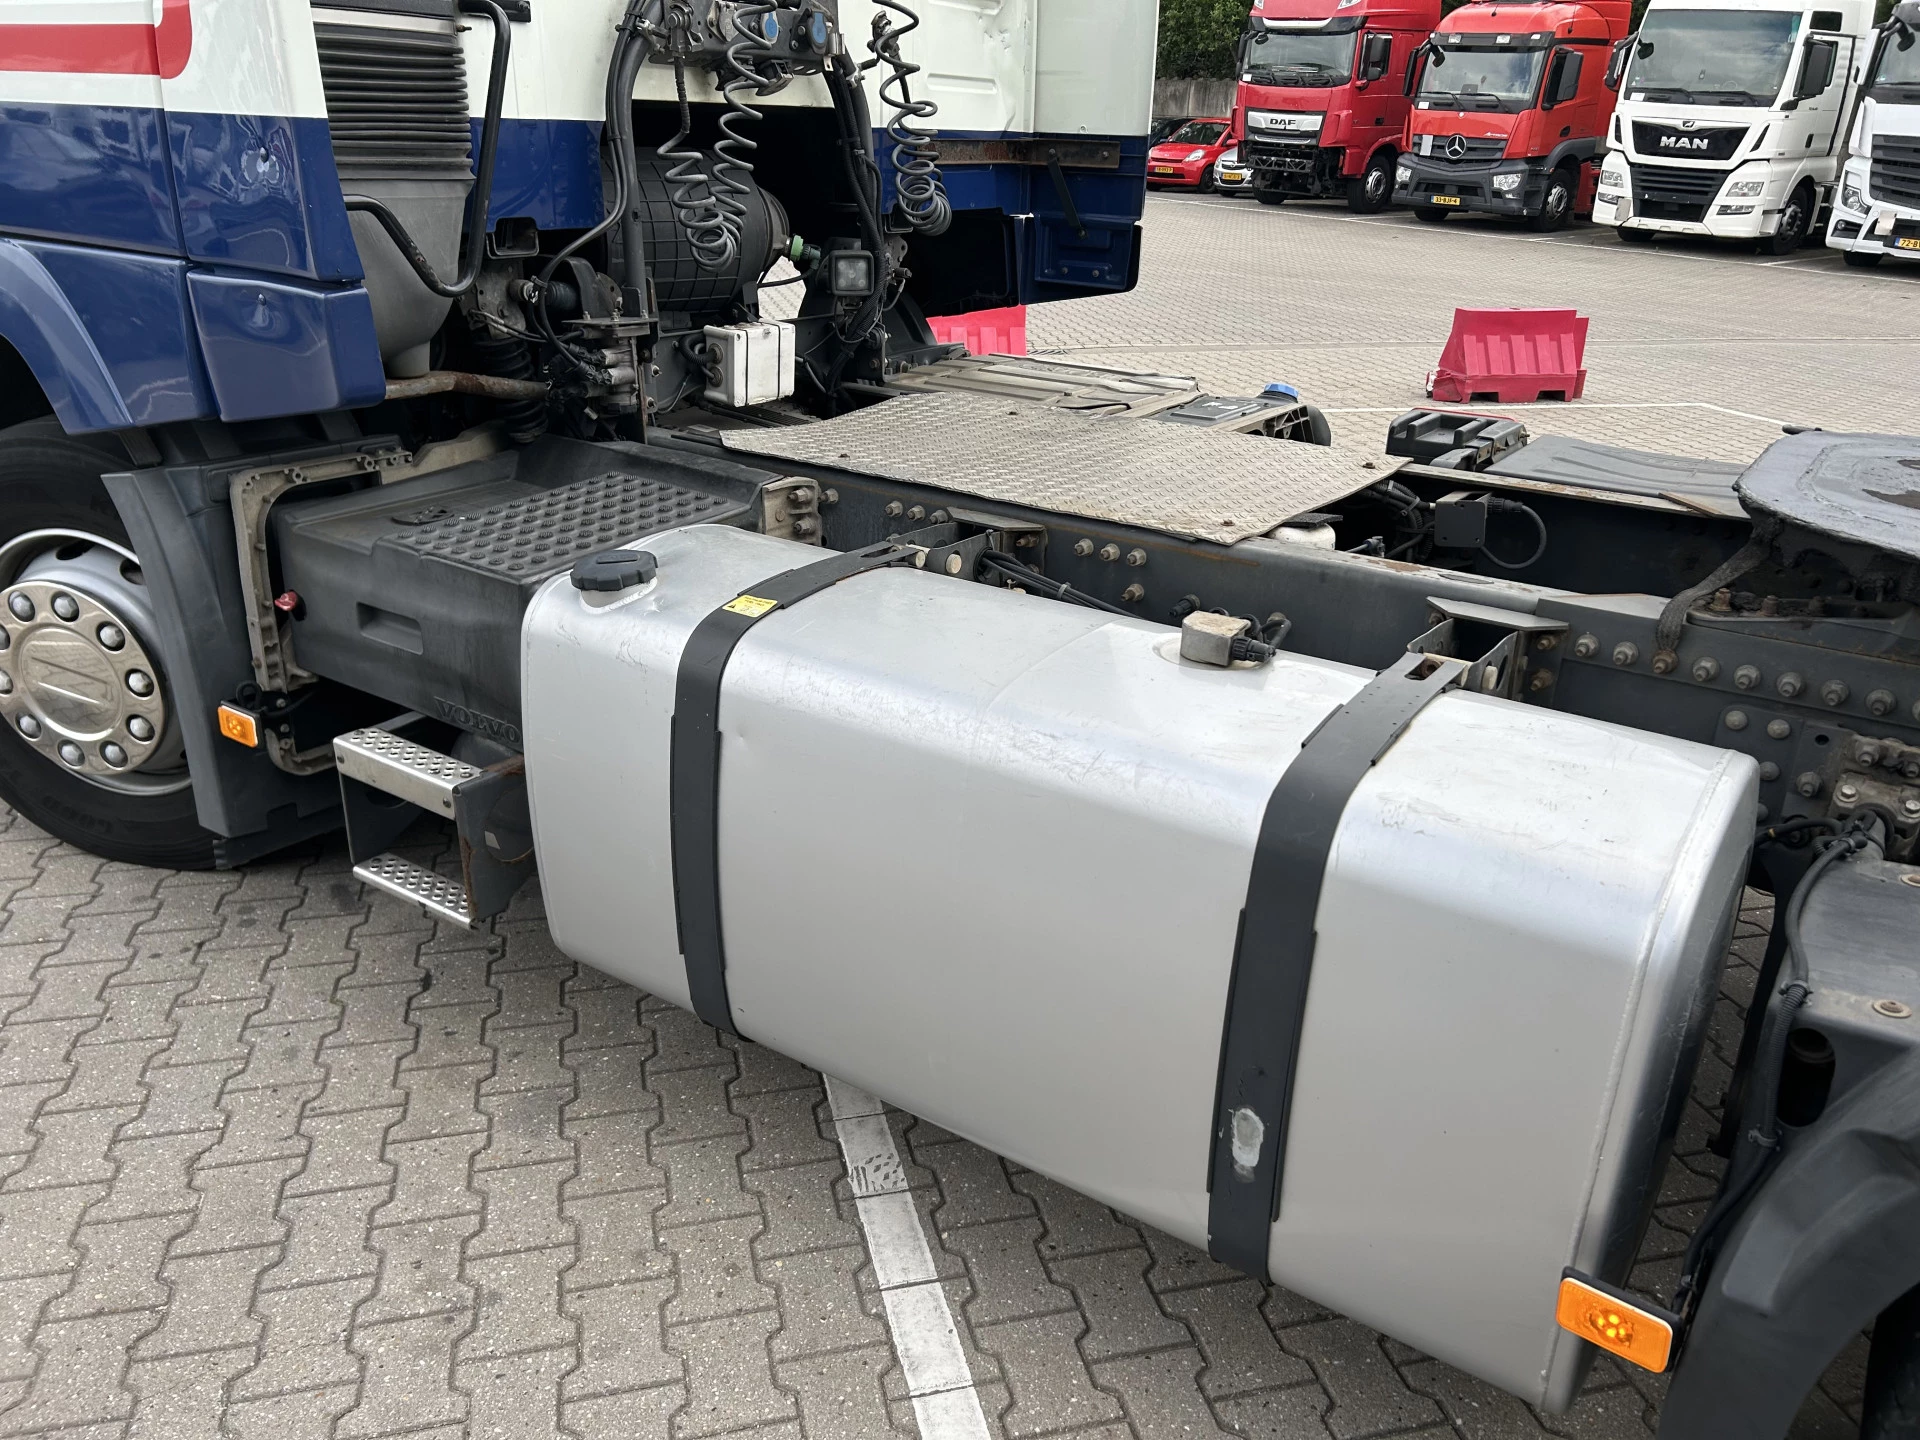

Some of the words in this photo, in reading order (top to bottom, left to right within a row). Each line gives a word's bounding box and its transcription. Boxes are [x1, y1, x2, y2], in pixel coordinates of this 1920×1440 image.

[1270, 118, 1296, 126] DAF
[1660, 136, 1709, 150] MAN
[1901, 239, 1920, 248] 72-B
[433, 695, 523, 743] VOLVO
